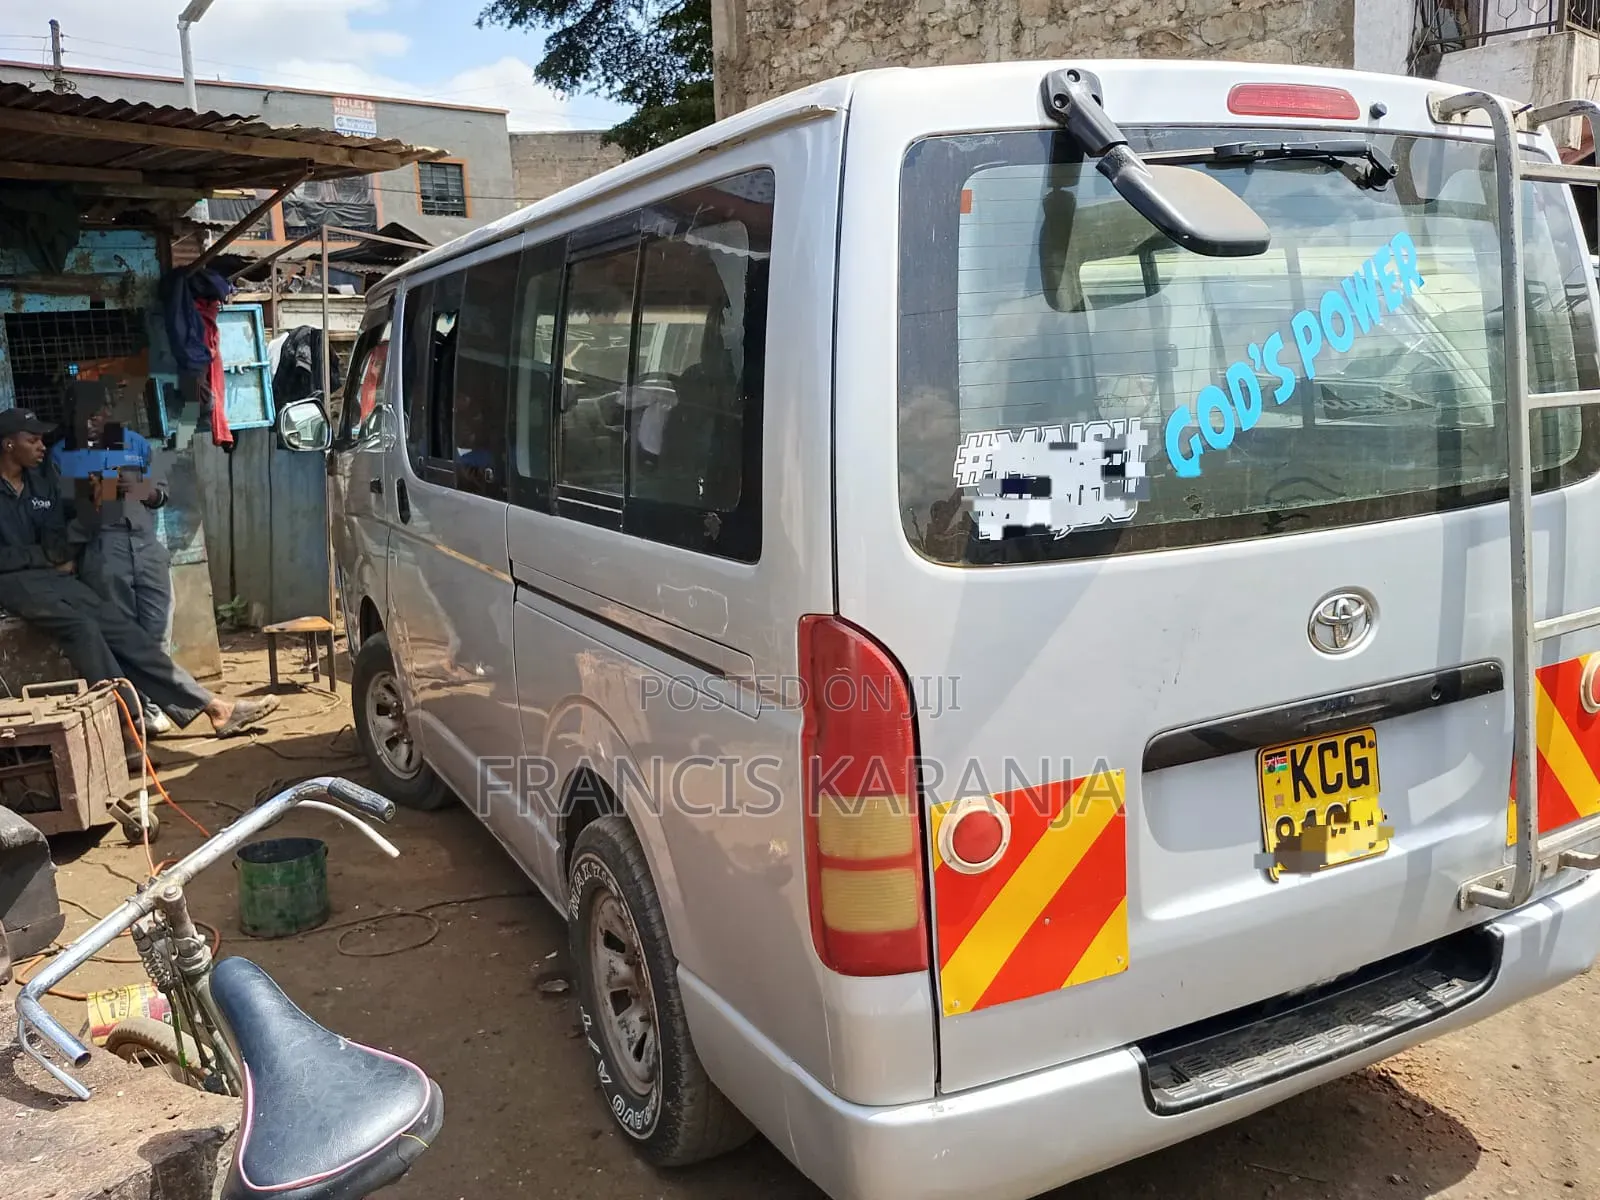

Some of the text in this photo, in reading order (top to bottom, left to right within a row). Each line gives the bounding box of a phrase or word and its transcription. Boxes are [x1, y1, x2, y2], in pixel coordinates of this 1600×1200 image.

[1165, 231, 1424, 478] GOD'S POWER
[1290, 735, 1370, 803] KCG
